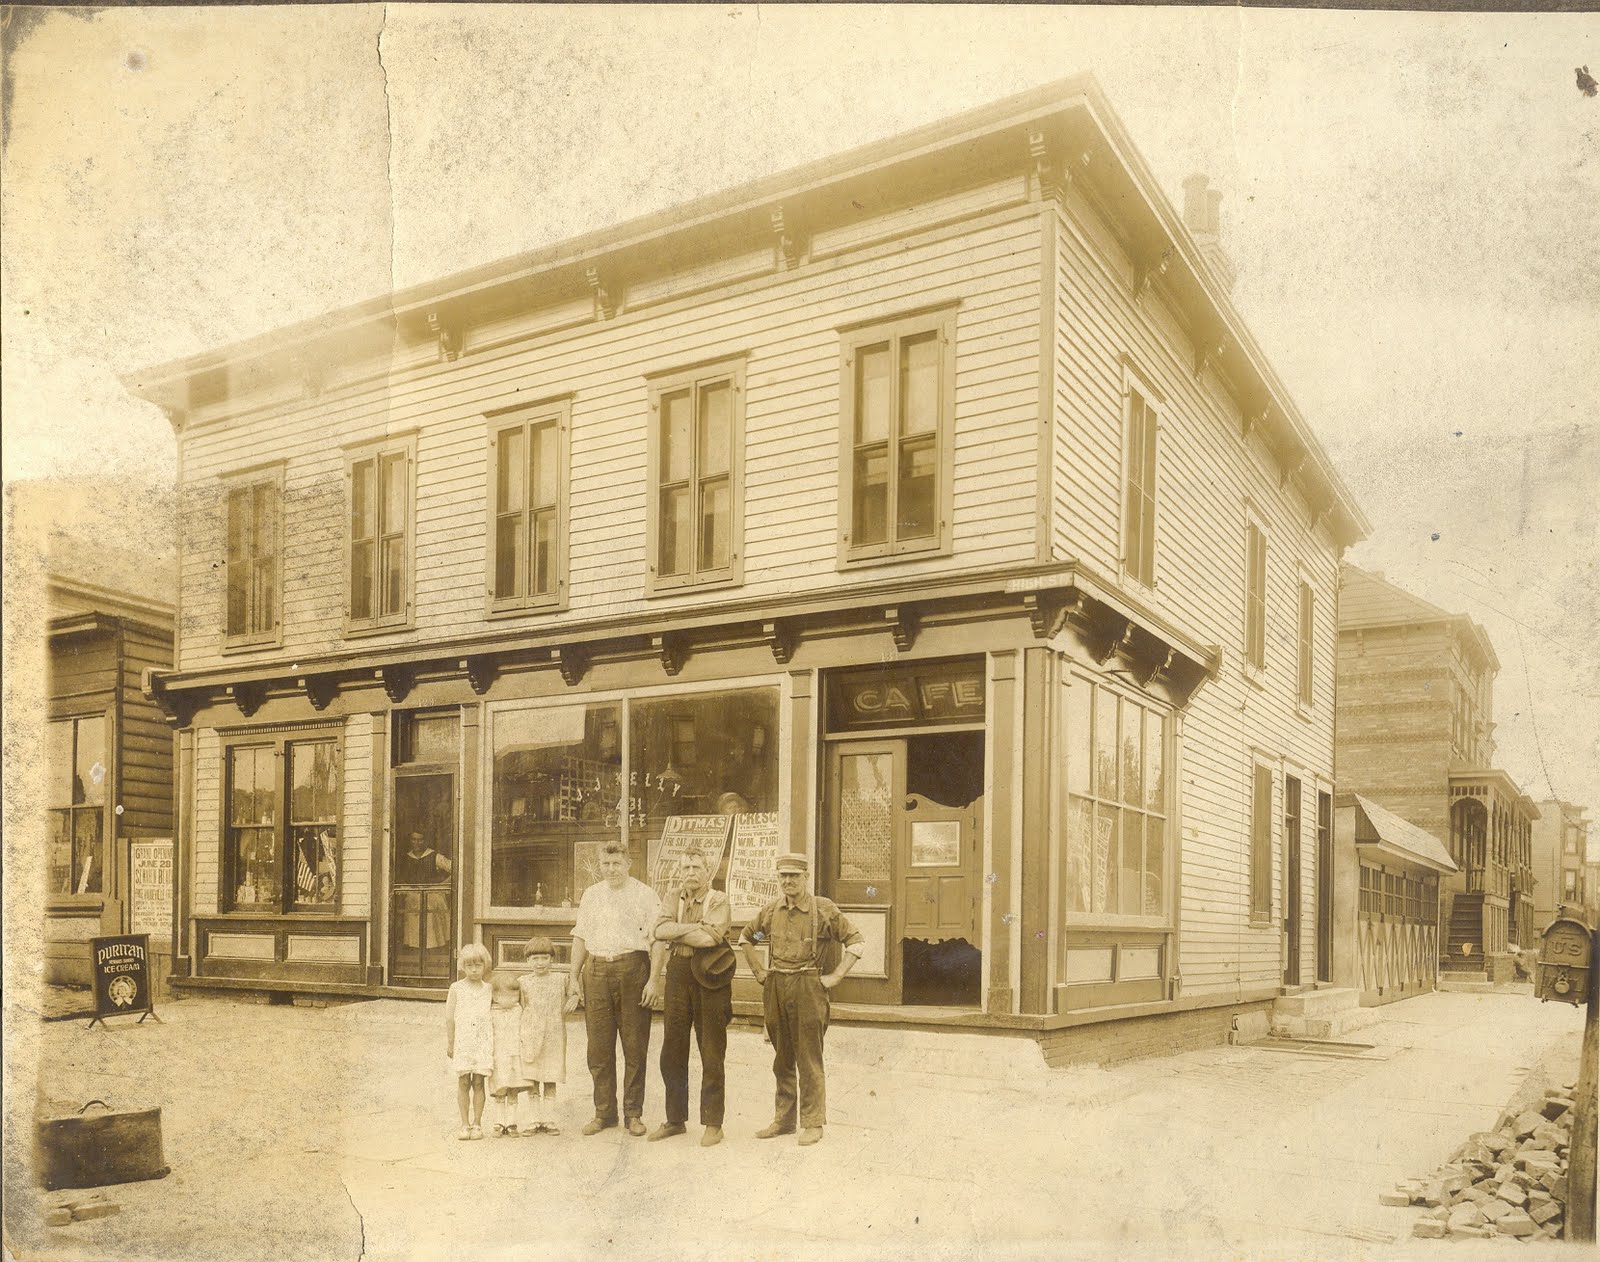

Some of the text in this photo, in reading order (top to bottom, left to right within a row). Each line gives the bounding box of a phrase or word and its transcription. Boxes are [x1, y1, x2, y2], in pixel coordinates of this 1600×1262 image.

[853, 680, 984, 713] CAFE
[668, 817, 726, 833] DITMAS
[738, 812, 779, 825] CRESC
[103, 962, 140, 974] ICE CREAM
